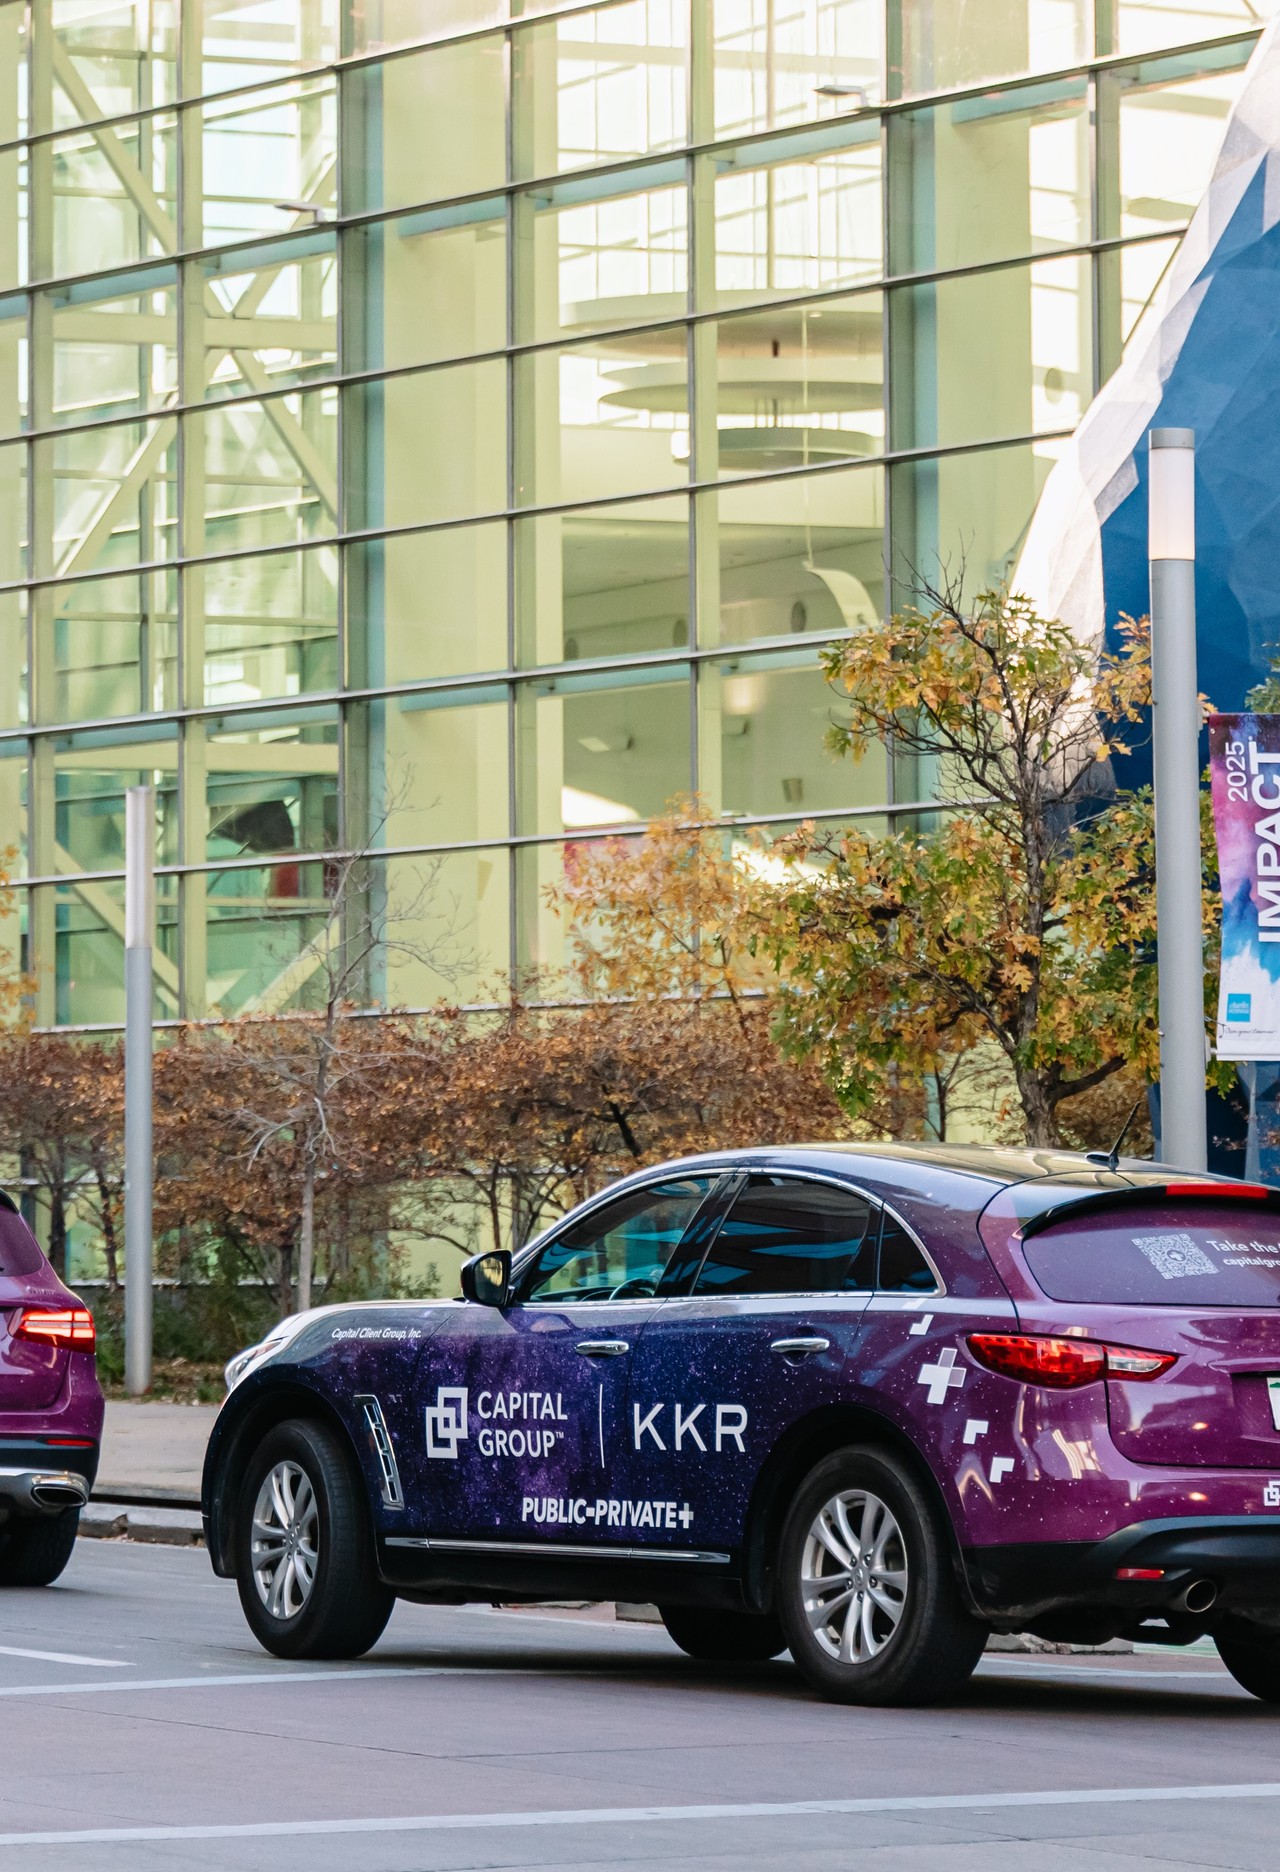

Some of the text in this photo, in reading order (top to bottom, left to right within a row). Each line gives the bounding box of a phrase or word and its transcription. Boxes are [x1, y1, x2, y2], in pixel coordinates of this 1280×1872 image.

[1225, 741, 1249, 802] 2025
[1206, 1240, 1250, 1252] Take
[1249, 1241, 1279, 1254] the
[331, 1327, 360, 1341] Capital
[359, 1327, 382, 1339] Client
[382, 1327, 407, 1341] Group,
[477, 1391, 568, 1420] CAPITAL
[633, 1403, 748, 1453] KKR
